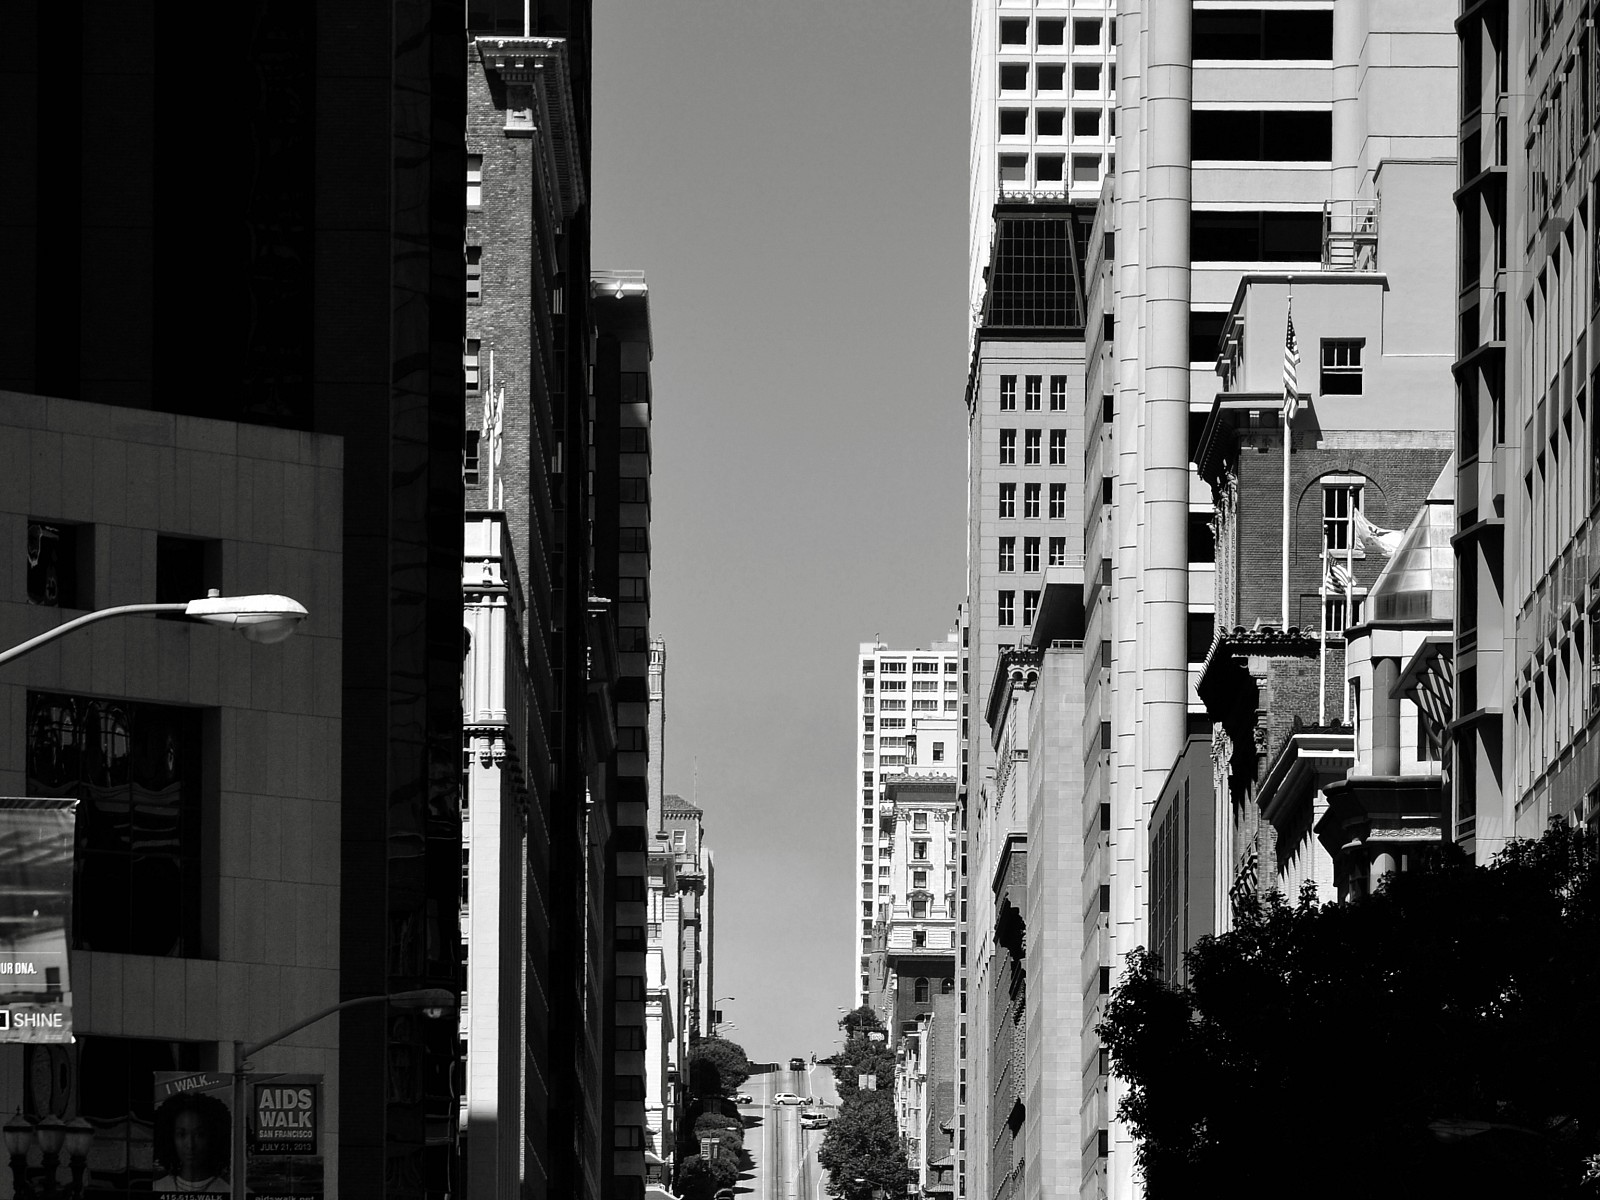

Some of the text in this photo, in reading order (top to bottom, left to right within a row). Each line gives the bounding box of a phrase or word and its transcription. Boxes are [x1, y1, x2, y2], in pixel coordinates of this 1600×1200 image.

[15, 962, 37, 974] DNA.
[13, 1013, 62, 1027] SHINE
[165, 1074, 219, 1095] I WALK...
[259, 1088, 312, 1109] AIDS
[259, 1111, 312, 1128] WALK
[259, 1130, 313, 1138] SAN FRANCISCO
[260, 1143, 279, 1151] JULY
[294, 1143, 312, 1151] 2013
